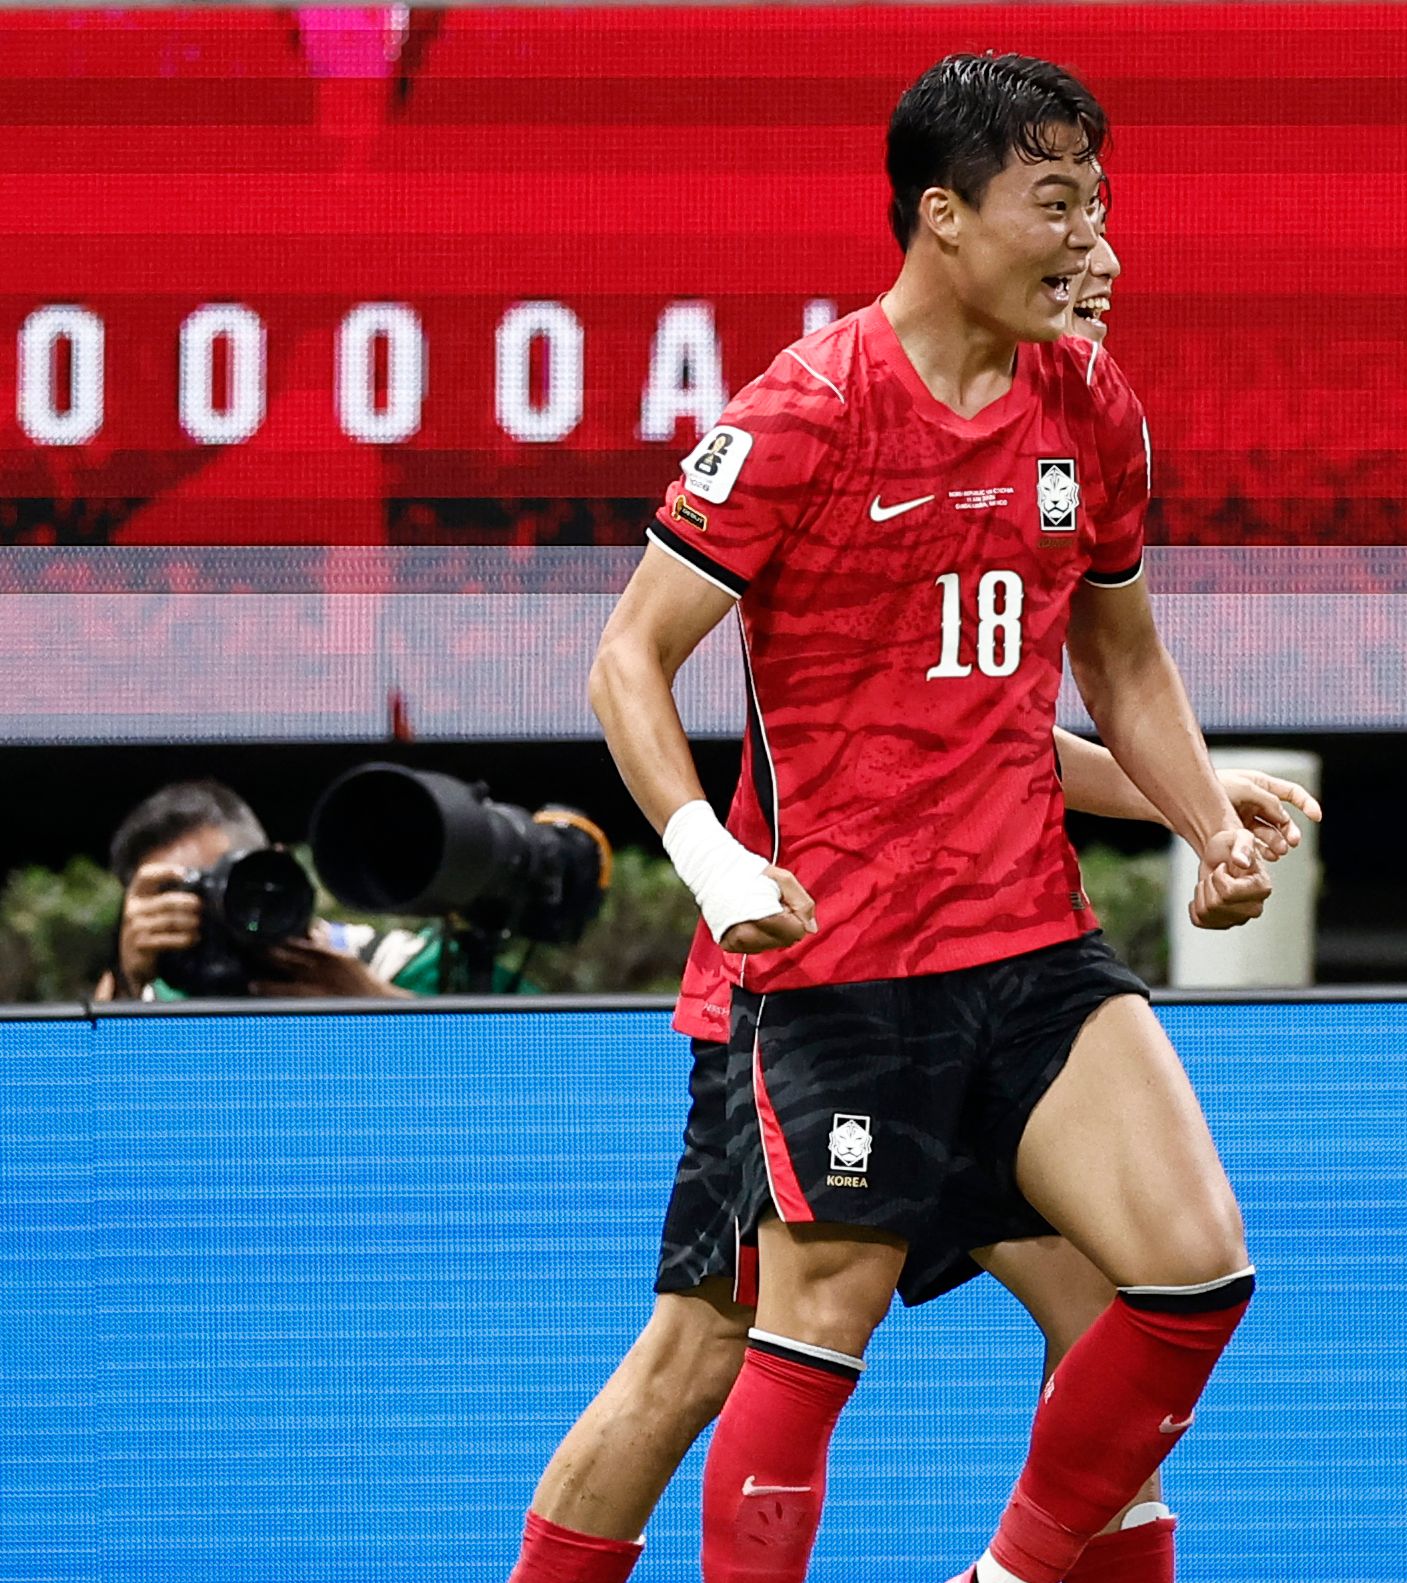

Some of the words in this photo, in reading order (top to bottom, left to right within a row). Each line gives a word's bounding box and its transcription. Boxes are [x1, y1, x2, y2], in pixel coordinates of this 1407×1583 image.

[17, 299, 838, 445] OOOOA
[926, 570, 1024, 681] 18
[826, 1174, 869, 1189] KOREA
